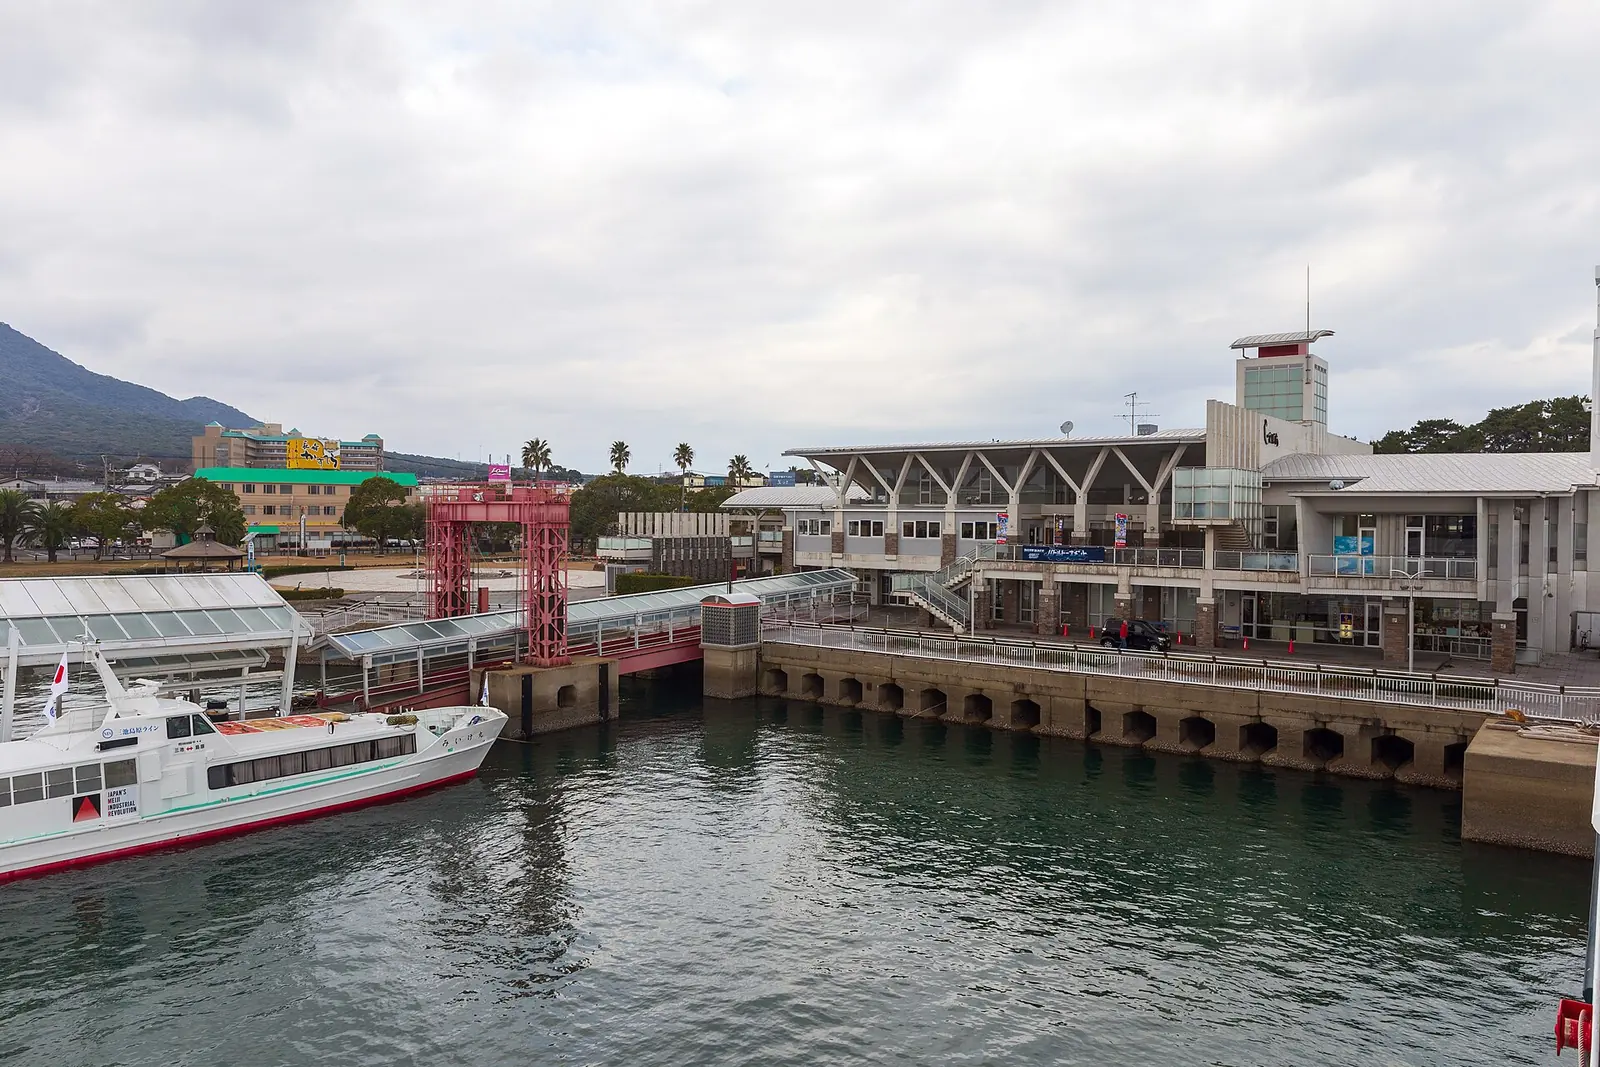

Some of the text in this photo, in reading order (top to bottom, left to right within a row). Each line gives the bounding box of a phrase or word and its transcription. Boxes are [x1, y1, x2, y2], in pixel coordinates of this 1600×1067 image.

[108, 789, 126, 797] JAPAN'S
[108, 801, 135, 810] INDUSTRIAL
[108, 807, 136, 816] REVOLUTION
